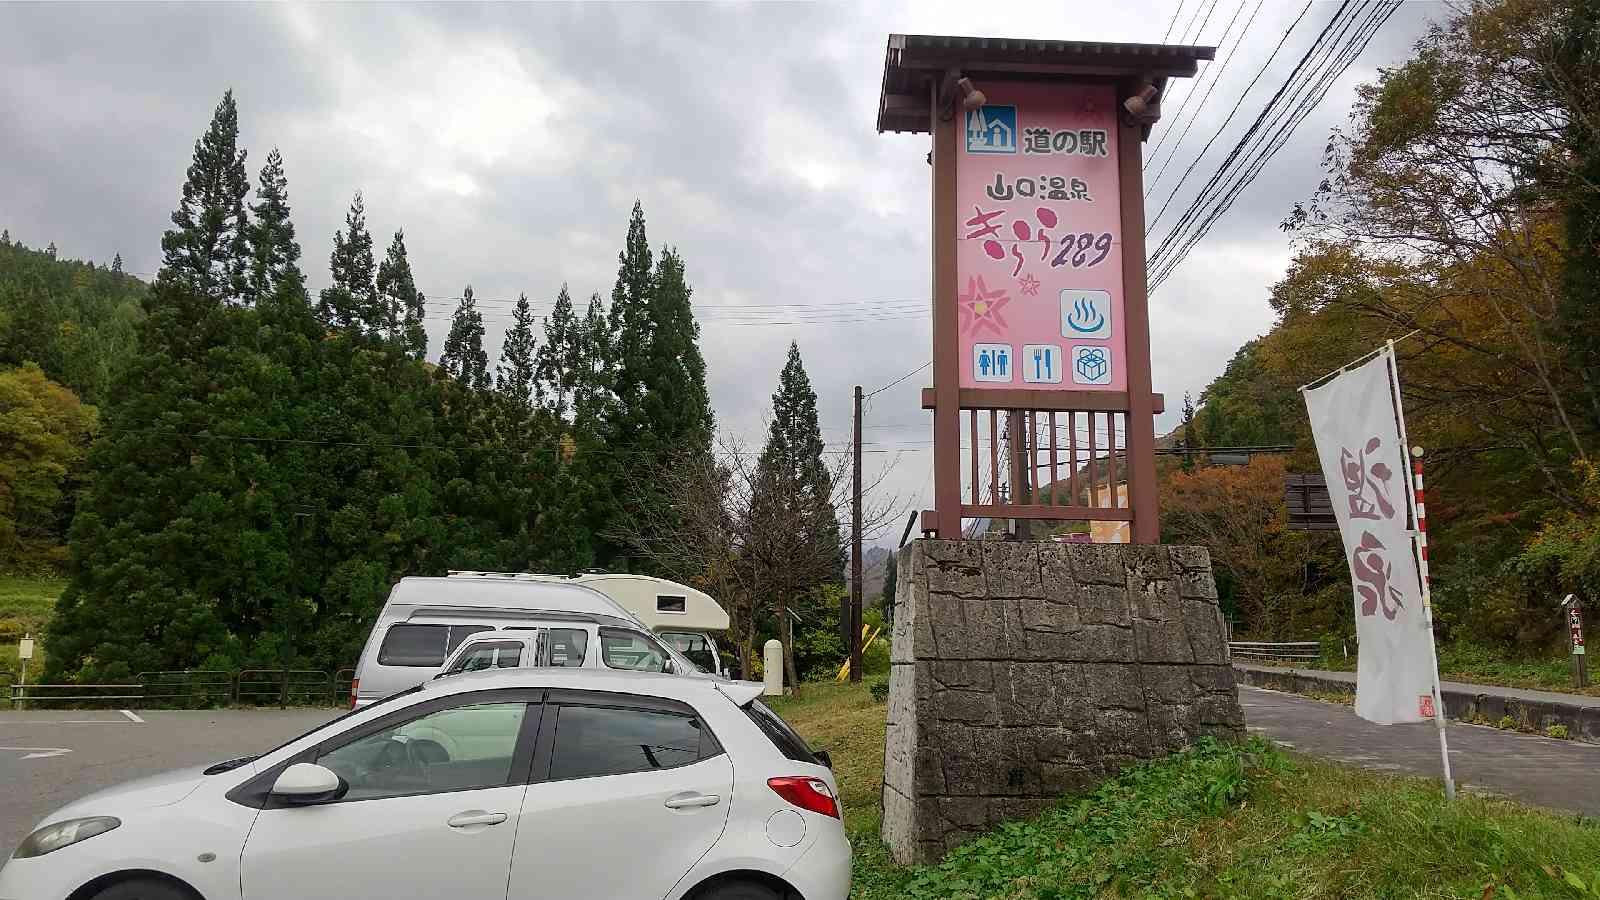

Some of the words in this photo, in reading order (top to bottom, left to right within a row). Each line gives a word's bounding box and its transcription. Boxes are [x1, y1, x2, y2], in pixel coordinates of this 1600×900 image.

[1024, 128, 1107, 156] 道の駅
[986, 173, 1093, 202] 山口温泉
[966, 205, 1058, 277] きらら
[1051, 232, 1113, 268] 289
